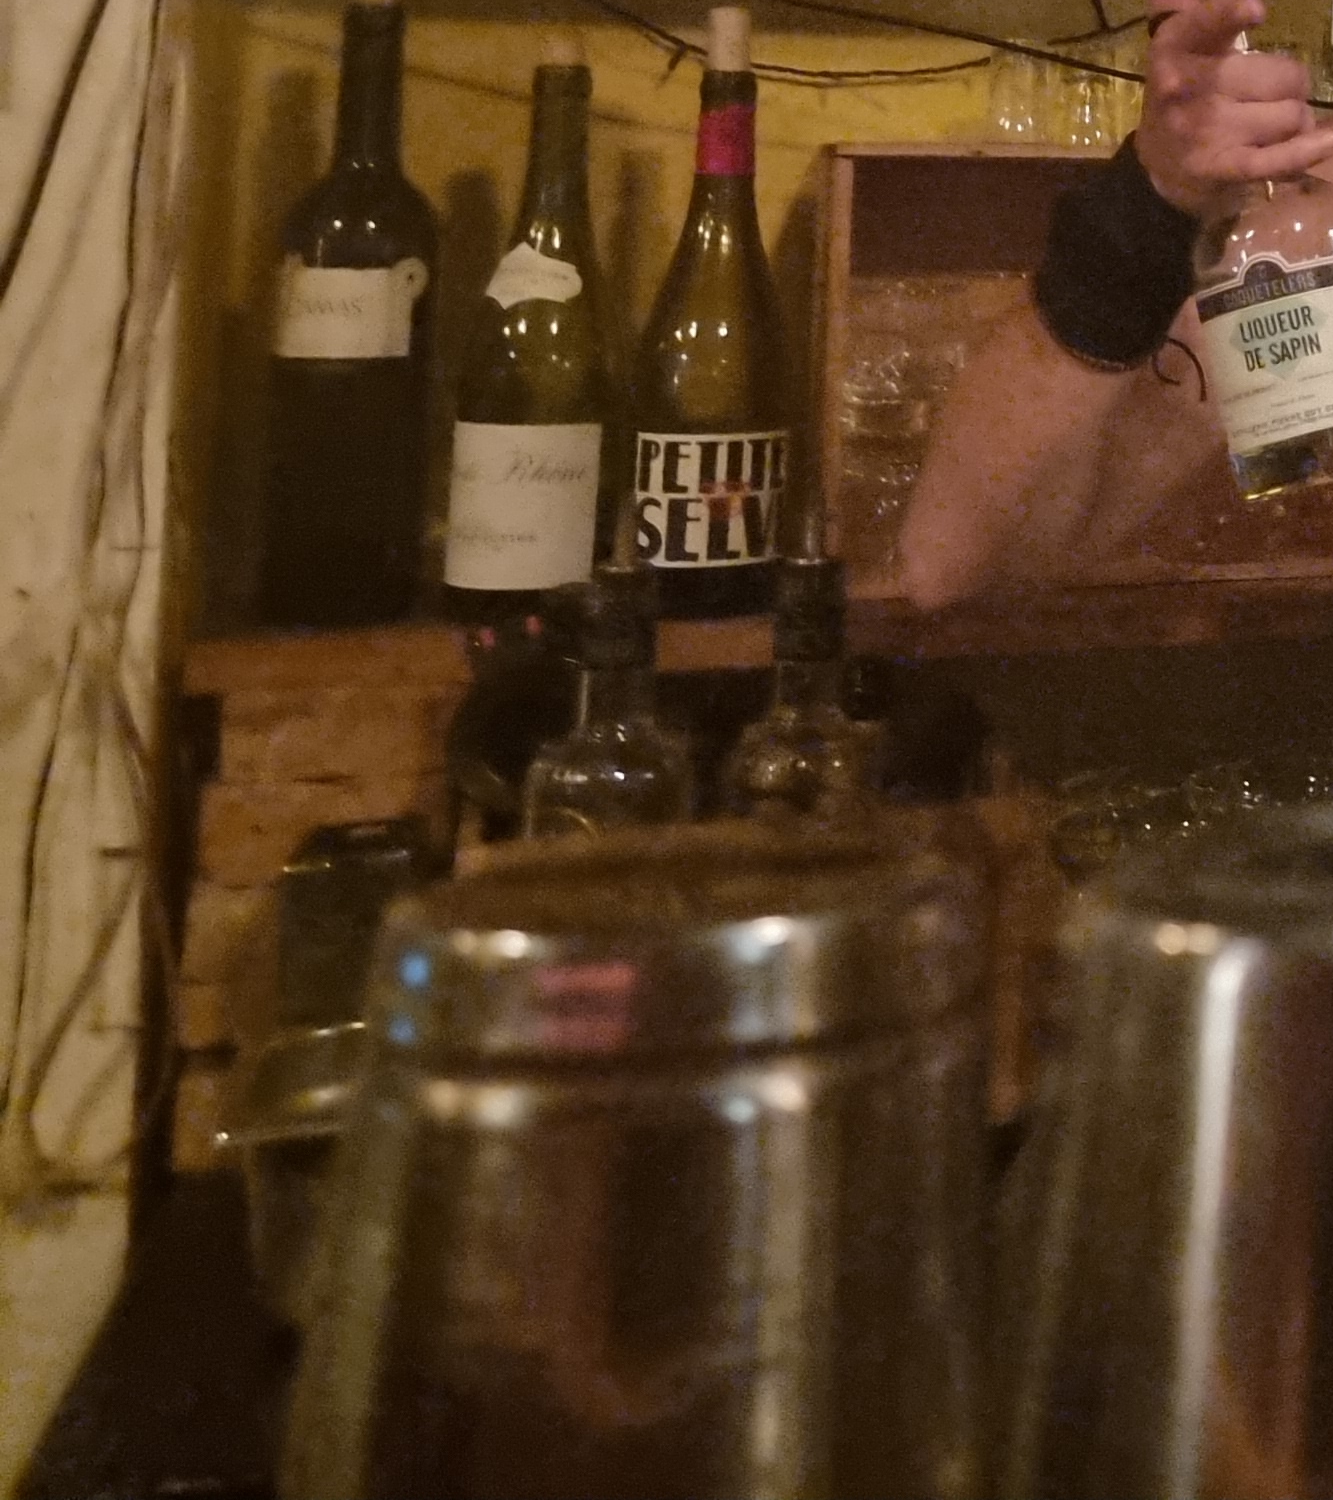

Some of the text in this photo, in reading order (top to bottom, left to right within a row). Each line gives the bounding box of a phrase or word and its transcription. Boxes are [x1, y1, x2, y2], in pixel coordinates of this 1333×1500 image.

[1238, 304, 1315, 344] LIQUEUR
[1244, 348, 1266, 373] DE
[1269, 332, 1322, 366] SAPIN
